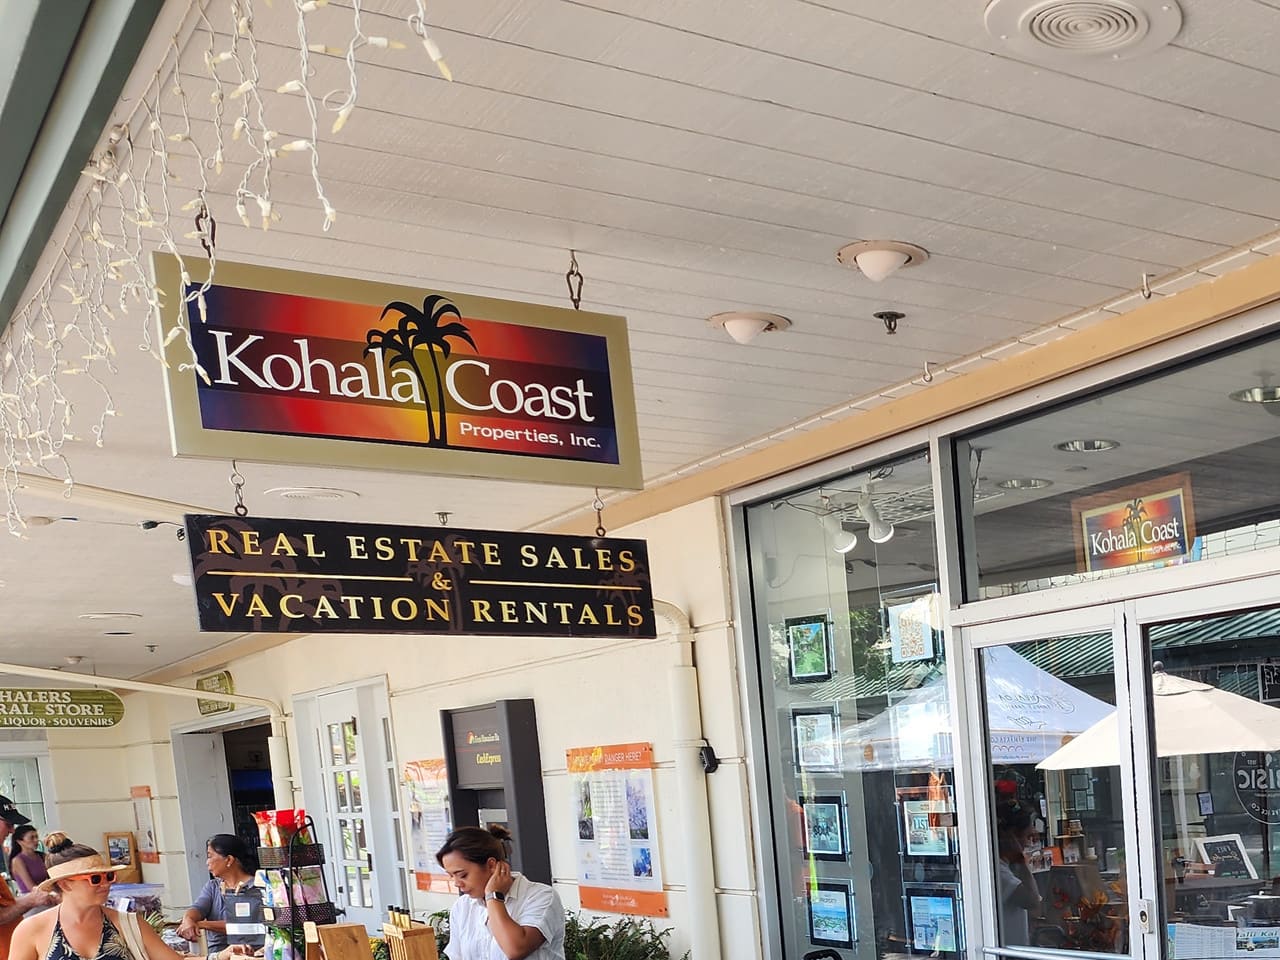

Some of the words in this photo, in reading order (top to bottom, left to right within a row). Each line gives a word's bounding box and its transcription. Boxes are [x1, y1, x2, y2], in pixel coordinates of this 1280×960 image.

[208, 330, 425, 404] Kohala
[445, 360, 595, 422] Coast
[460, 422, 563, 447] Properties,
[570, 434, 601, 448] Inc.
[208, 529, 326, 558] REAL
[347, 536, 501, 566] ESTATE
[521, 544, 636, 573] SALES
[1090, 526, 1137, 555] Kohala
[1141, 517, 1179, 543] Coast
[432, 572, 452, 590] &
[211, 593, 449, 622] VACATION
[473, 601, 644, 627] RENTALS
[4, 717, 46, 727] LIQUOR
[53, 718, 114, 726] SOUVENIRS
[45, 704, 104, 715] STORE
